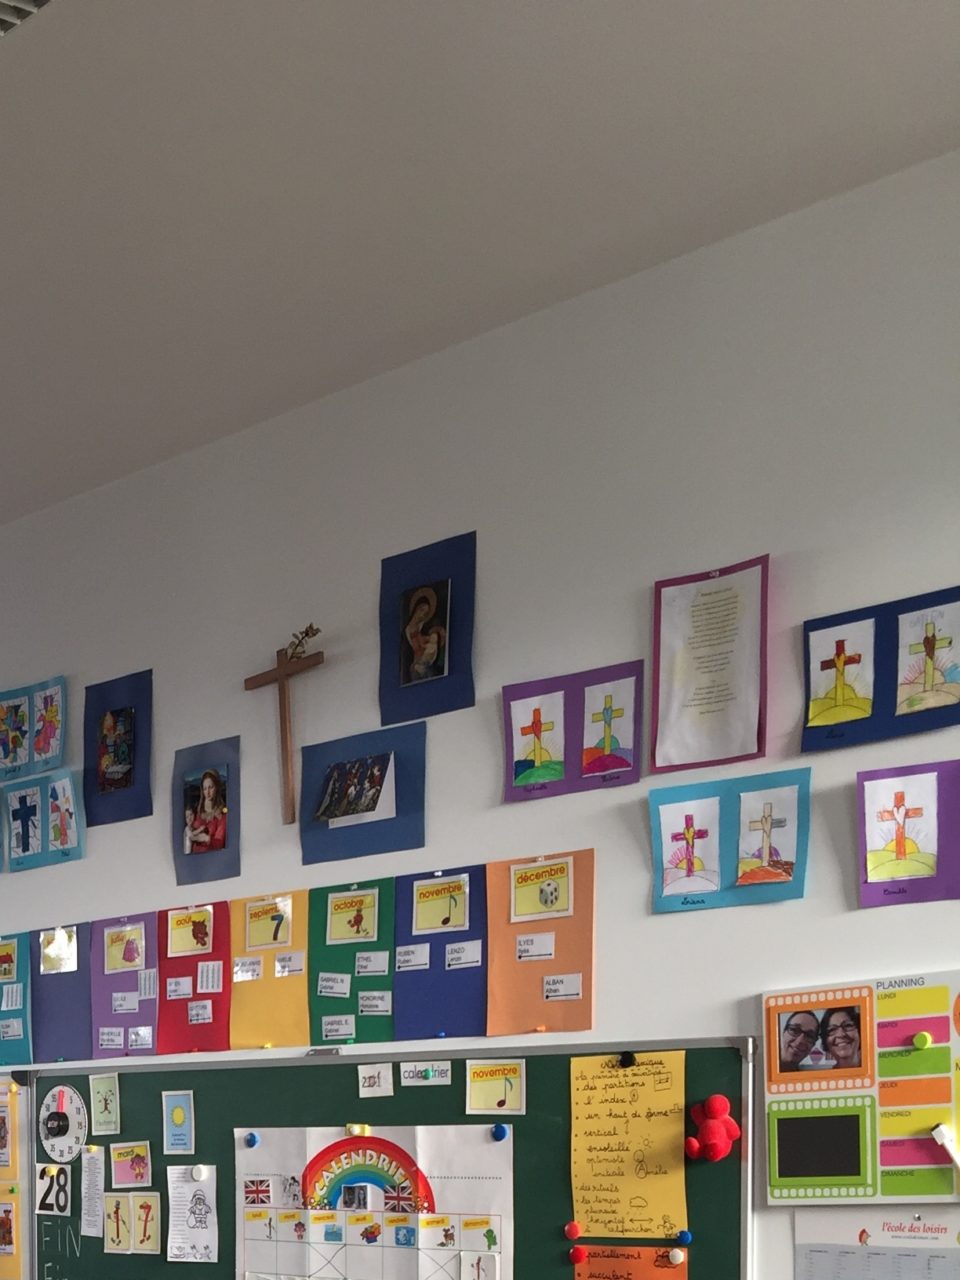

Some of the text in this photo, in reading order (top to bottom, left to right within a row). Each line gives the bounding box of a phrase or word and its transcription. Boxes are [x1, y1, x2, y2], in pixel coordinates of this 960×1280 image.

[517, 865, 566, 885] décembre
[419, 883, 463, 899] novembre
[333, 898, 364, 912] octobre
[545, 978, 564, 986] ALBAN
[876, 977, 925, 990] PLANNING
[877, 992, 896, 1000] LUNDI
[472, 1066, 518, 1079] novembre
[602, 1079, 646, 1094] partitions
[879, 1081, 898, 1089] JEUDI
[599, 1092, 627, 1105] index
[880, 1110, 912, 1119] VENDREDI
[584, 1126, 619, 1137] vertical
[881, 1170, 915, 1178] DIMANCHE
[38, 1166, 69, 1214] 28
[882, 1221, 948, 1234] l'école des loisirs
